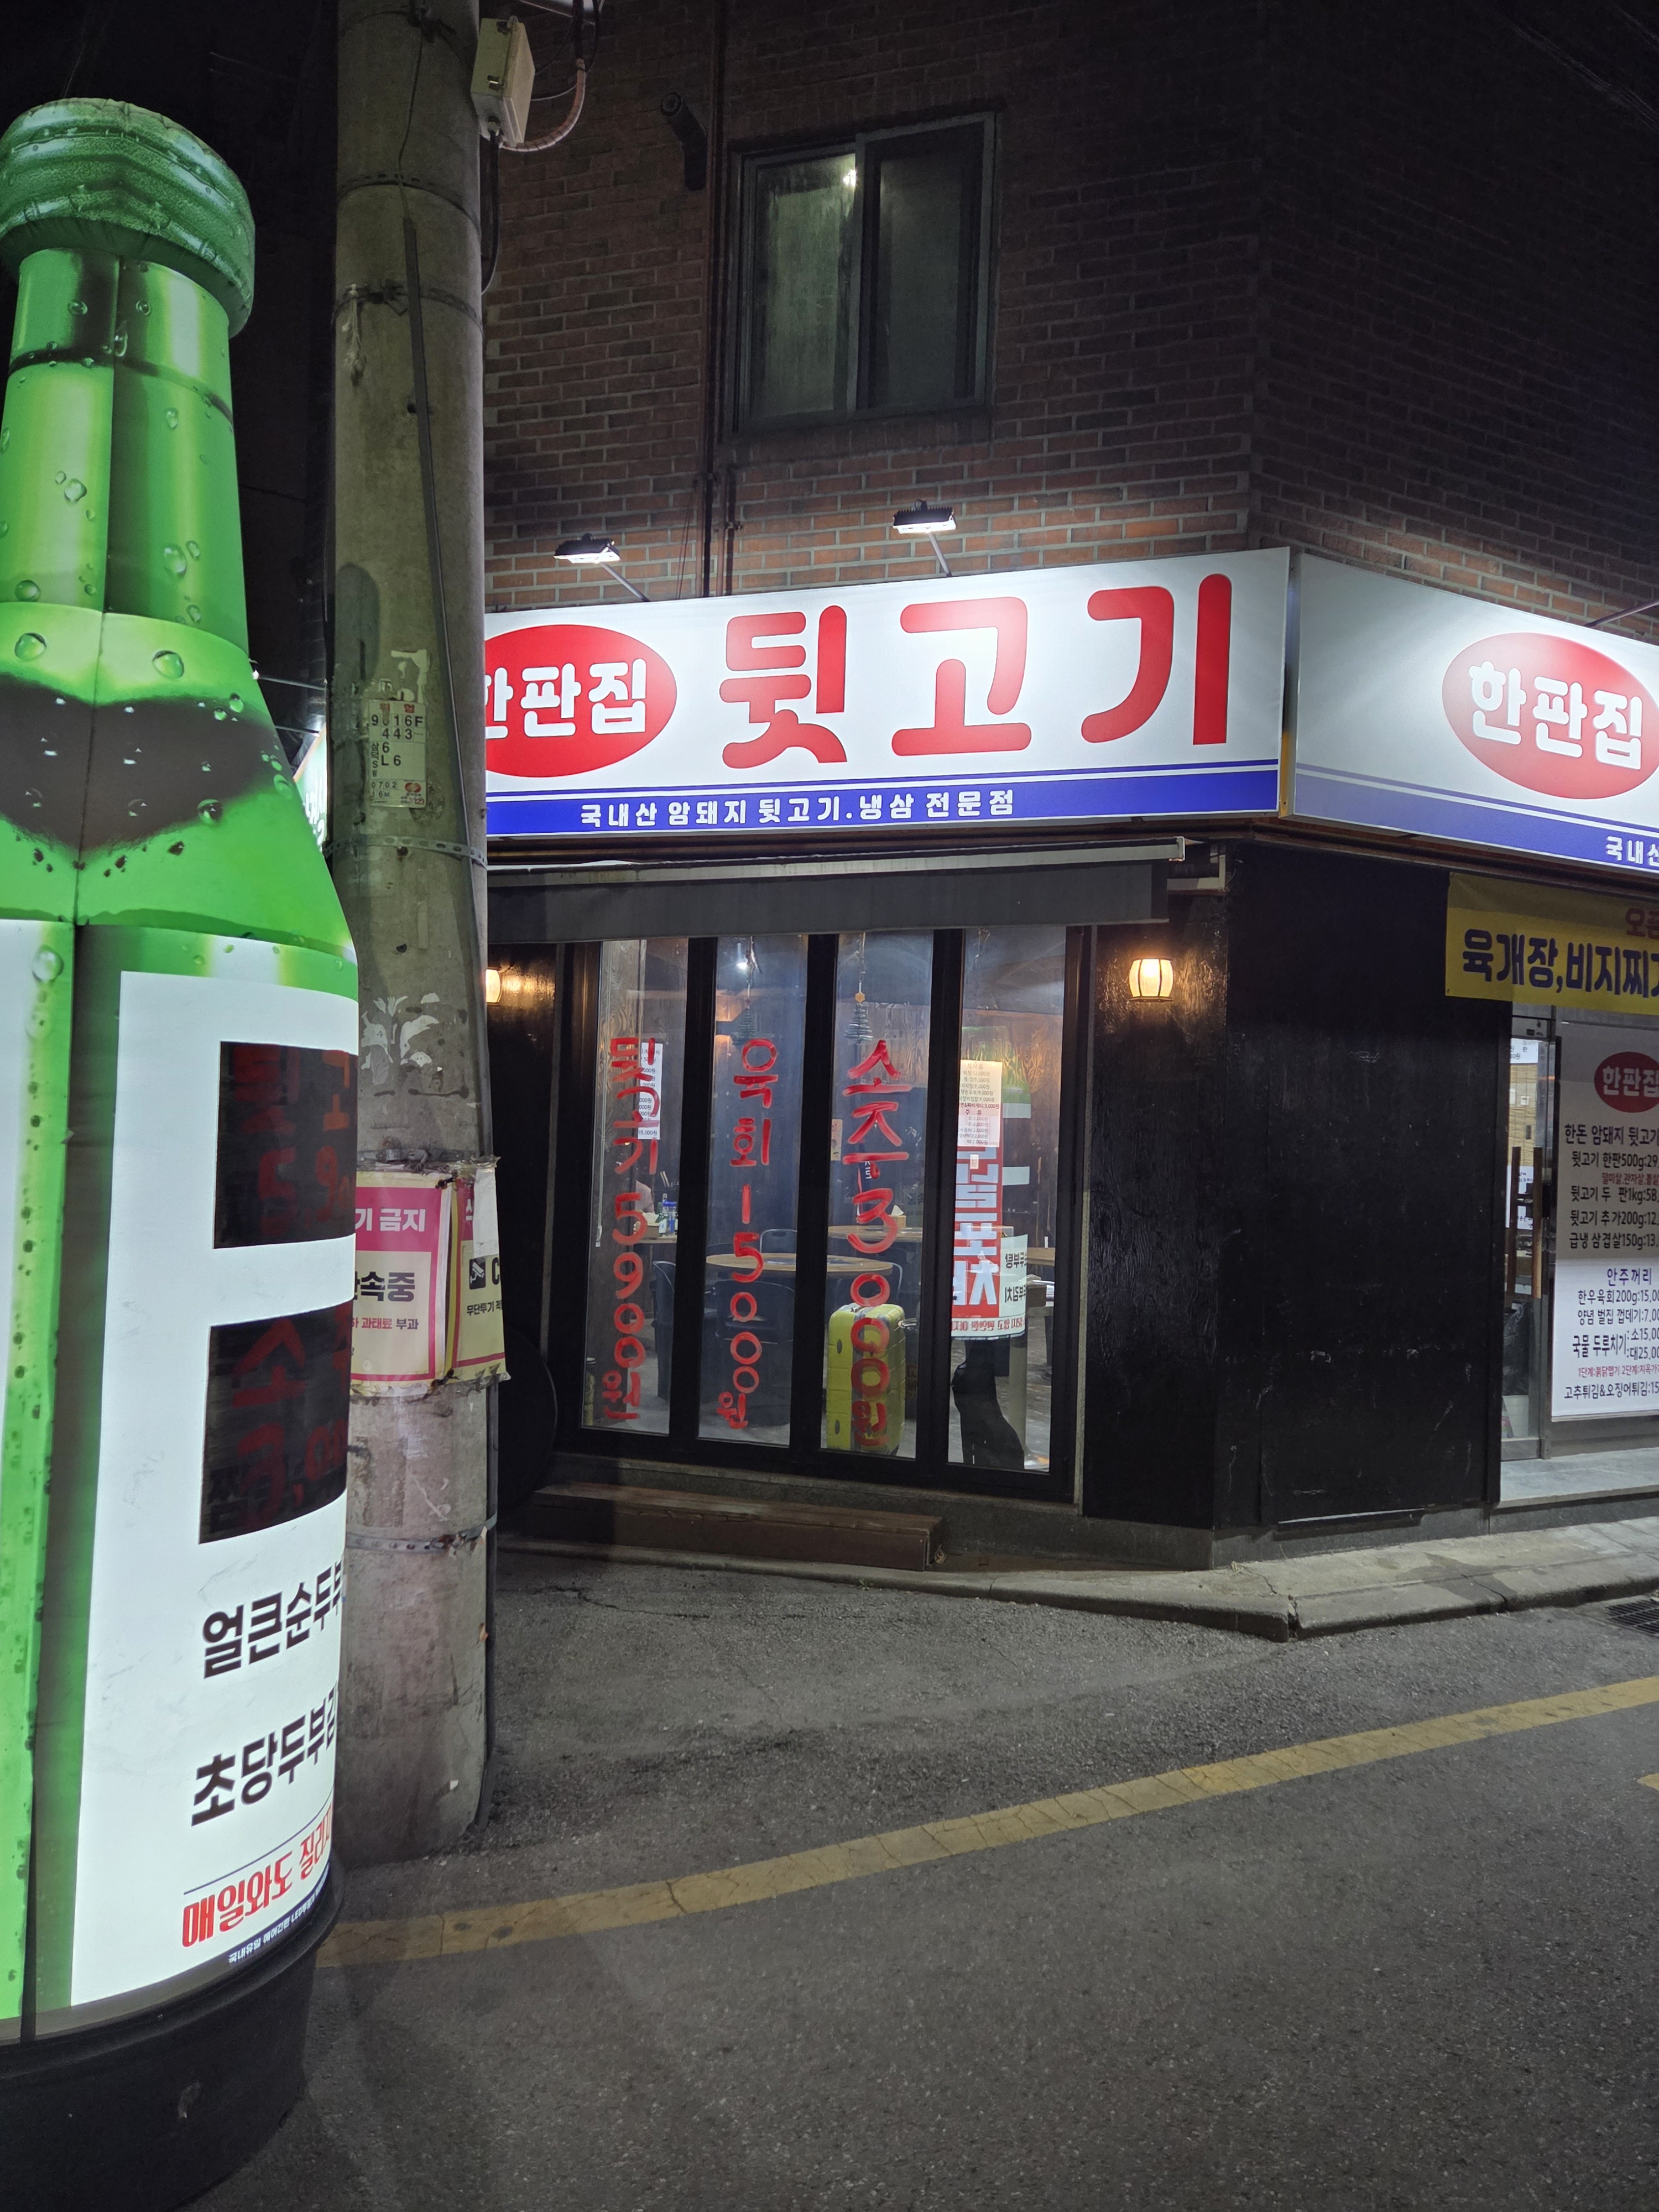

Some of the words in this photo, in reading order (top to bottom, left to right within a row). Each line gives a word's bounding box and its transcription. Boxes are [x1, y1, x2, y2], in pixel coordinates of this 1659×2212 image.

[719, 573, 1232, 769] 뒷고기
[1469, 660, 1643, 770] 한판집
[382, 728, 413, 740] 443
[382, 742, 390, 753] 6
[580, 803, 658, 827] 국내산
[668, 800, 747, 826] 암돼지
[926, 790, 1014, 817] 전문점
[730, 1037, 778, 1167] 육회
[842, 1039, 913, 1179] 소주
[1564, 1123, 1588, 1145] 한돈
[1592, 1125, 1624, 1146] 암돼지
[1628, 1126, 1659, 1147] 뒷고기
[1572, 1150, 1599, 1168] 뒷고기
[1571, 1185, 1599, 1202] 뒷고기
[1601, 1187, 1611, 1202] 두
[379, 1208, 426, 1232] 금지
[1570, 1210, 1598, 1227] 뒷고기
[1606, 1267, 1652, 1287] 안주꺼리
[466, 1301, 494, 1316] 무단투기
[1577, 1309, 1594, 1326] 양념
[1598, 1308, 1614, 1325] 벌집
[361, 1317, 393, 1330] 과태료
[396, 1318, 419, 1330] 부과
[1572, 1334, 1590, 1359] 국물
[1593, 1333, 1626, 1357] 두루치기
[181, 1849, 293, 1949] 매일와도
